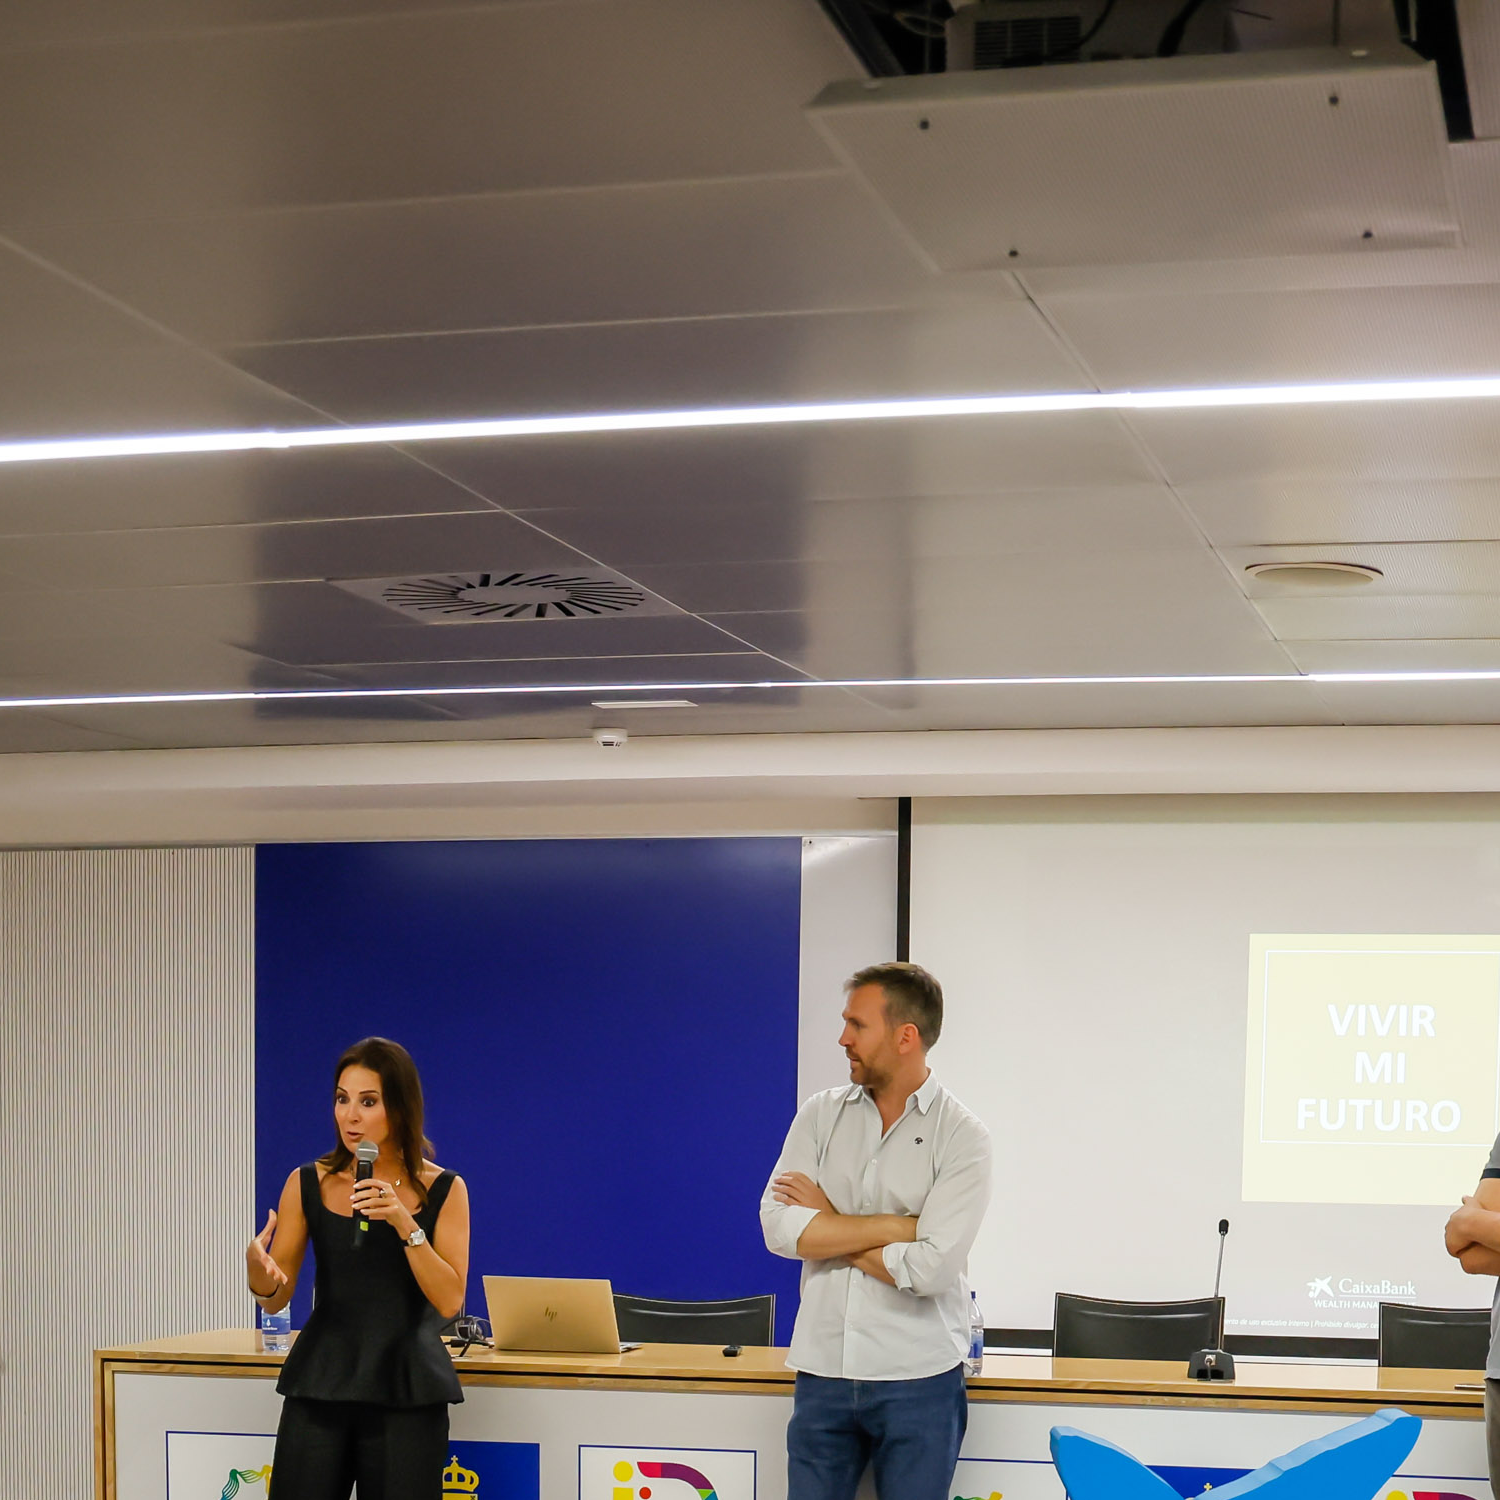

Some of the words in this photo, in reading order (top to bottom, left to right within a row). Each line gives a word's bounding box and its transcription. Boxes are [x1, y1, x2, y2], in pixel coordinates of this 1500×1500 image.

[1327, 1003, 1437, 1037] VIVIR
[1354, 1051, 1406, 1084] MI
[1296, 1098, 1462, 1133] FUTURO
[1338, 1278, 1416, 1295] CaixaBank
[1314, 1300, 1350, 1309] WEALTH
